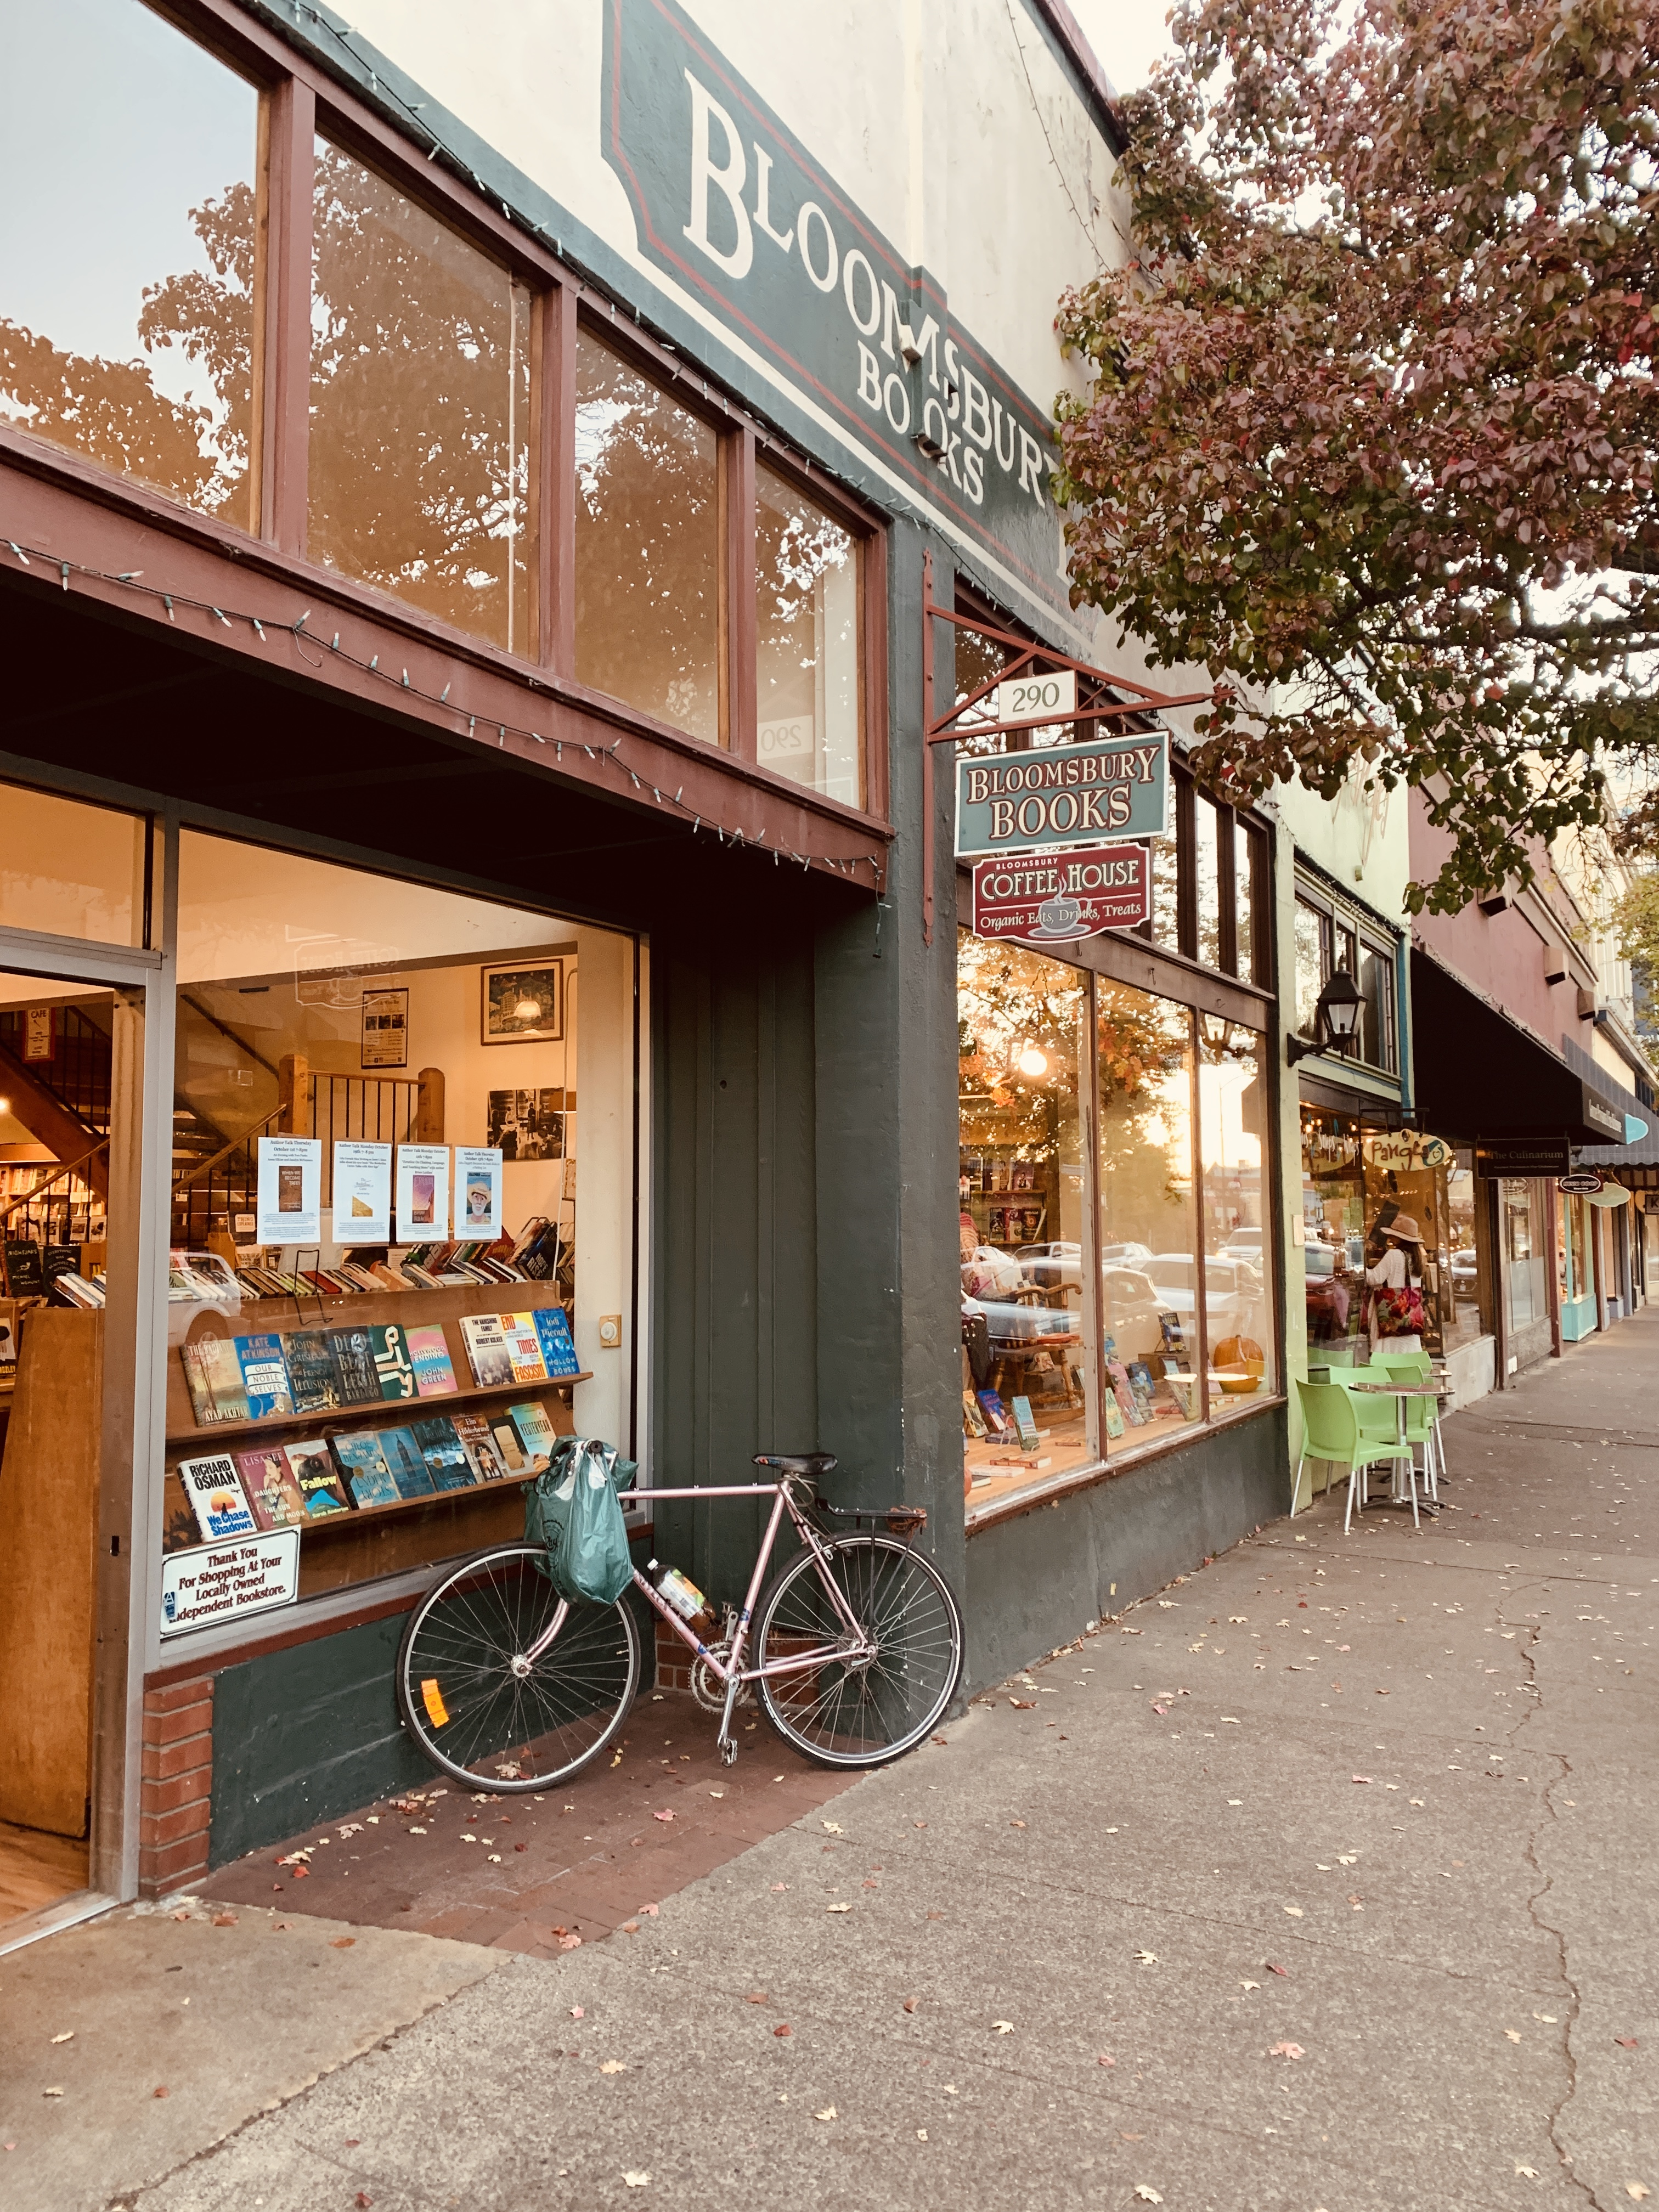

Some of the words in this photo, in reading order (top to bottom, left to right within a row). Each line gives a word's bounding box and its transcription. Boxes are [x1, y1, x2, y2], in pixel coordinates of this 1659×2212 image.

[682, 67, 1059, 508] BLOOMSBUR
[857, 340, 984, 505] BOOKS
[1012, 682, 1060, 712] 290
[968, 746, 1159, 803] BLOOMSBURY
[990, 785, 1131, 839] BOOKS
[996, 857, 1058, 870] BLOOMSBURY
[981, 868, 1058, 900] COFFEE
[1067, 860, 1139, 893] HOUSE
[980, 912, 1024, 931] Organic
[1027, 911, 1054, 924] Eats,
[1059, 902, 1101, 921] Drinks,
[1103, 902, 1142, 917] Treats
[31, 1010, 47, 1018] CAFE
[1491, 1151, 1507, 1159] The
[1509, 1150, 1564, 1159] Culinarium
[500, 1315, 516, 1331] END
[546, 1316, 559, 1326] Jodi
[541, 1327, 568, 1338] Picoult
[189, 1345, 202, 1356] THE
[248, 1337, 270, 1348] KATE
[291, 1339, 315, 1351] JOHN
[334, 1333, 367, 1352] DED
[516, 1338, 538, 1355] TIMES
[242, 1348, 280, 1359] ATKINSON
[337, 1351, 370, 1371] BET
[414, 1352, 445, 1363] ENDING
[549, 1357, 575, 1365] HOLLOW
[253, 1374, 279, 1383] NOBLE
[422, 1367, 443, 1376] JOHN
[514, 1363, 546, 1381] FASCISM
[553, 1366, 576, 1375] BONES
[422, 1374, 447, 1385] GREEN
[255, 1384, 281, 1393] SELVES
[205, 1408, 222, 1422] AYAD
[224, 1406, 249, 1420] AKHTAR
[458, 1424, 489, 1435] Hilderbrand
[519, 1419, 551, 1436] YESTERYEAR
[244, 1455, 266, 1466] LISA
[266, 1452, 284, 1461] SEE
[194, 1471, 236, 1491] OSMAN
[300, 1475, 336, 1491] Fallow
[254, 1485, 292, 1498] DAUGHTERS
[207, 1515, 222, 1526] We
[221, 1510, 250, 1523] Chase
[286, 1510, 305, 1519] MOON
[211, 1520, 253, 1536] Shadows
[207, 1550, 238, 1568] Thank
[239, 1548, 258, 1560] You
[178, 1577, 196, 1590] For
[198, 1565, 245, 1585] Shopping
[247, 1561, 258, 1573] At
[260, 1556, 282, 1570] Your
[196, 1582, 231, 1601] Locally
[233, 1572, 265, 1591] Owned
[169, 1596, 233, 1624] dependent
[236, 1584, 286, 1605] Bookstore.
